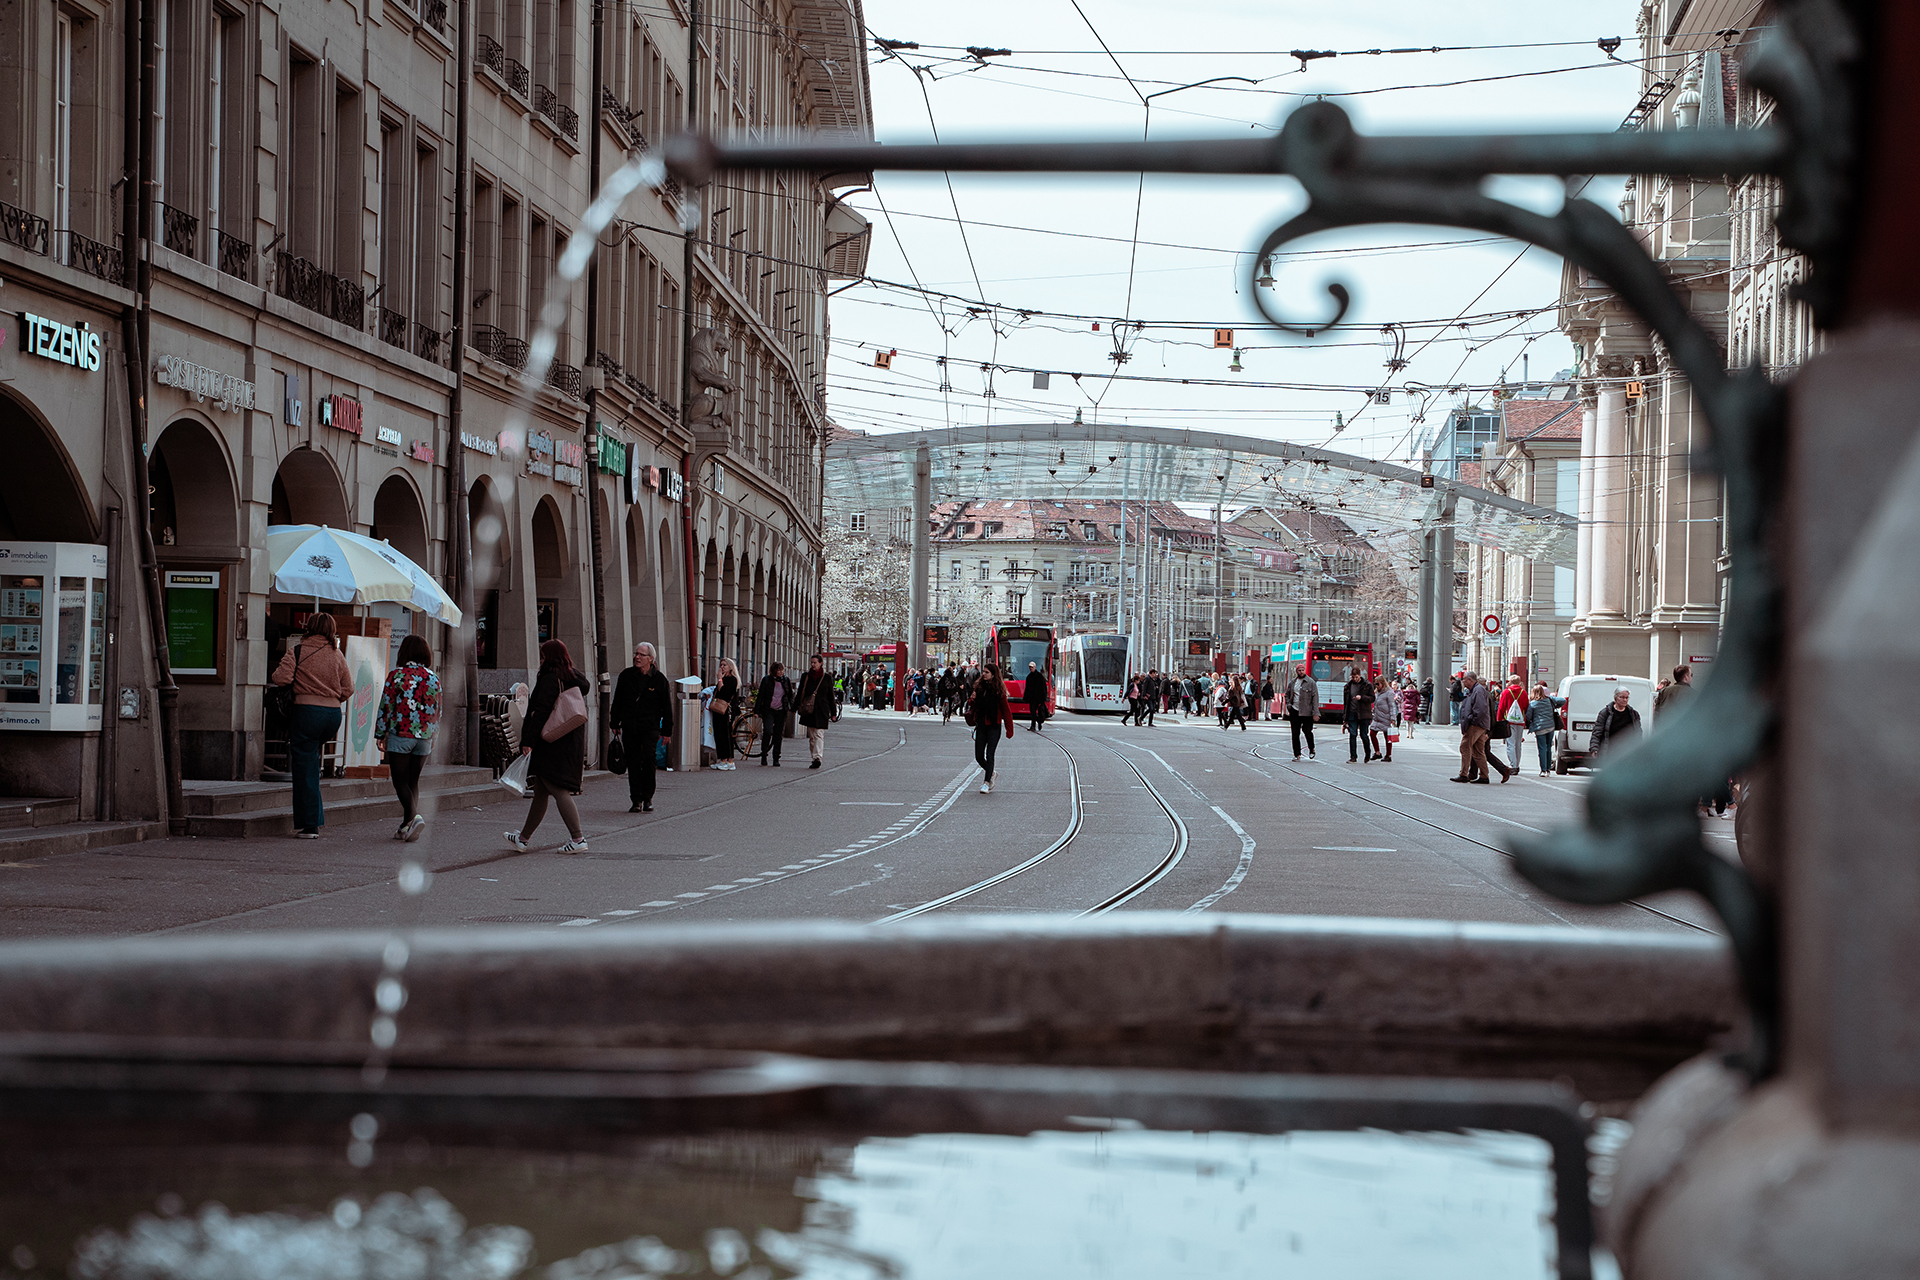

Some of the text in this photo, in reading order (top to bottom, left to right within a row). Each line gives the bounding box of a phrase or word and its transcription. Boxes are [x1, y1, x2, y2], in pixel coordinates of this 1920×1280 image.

[25, 312, 100, 372] TEZENIS
[1376, 392, 1389, 403] 15
[11, 551, 48, 559] immobilien
